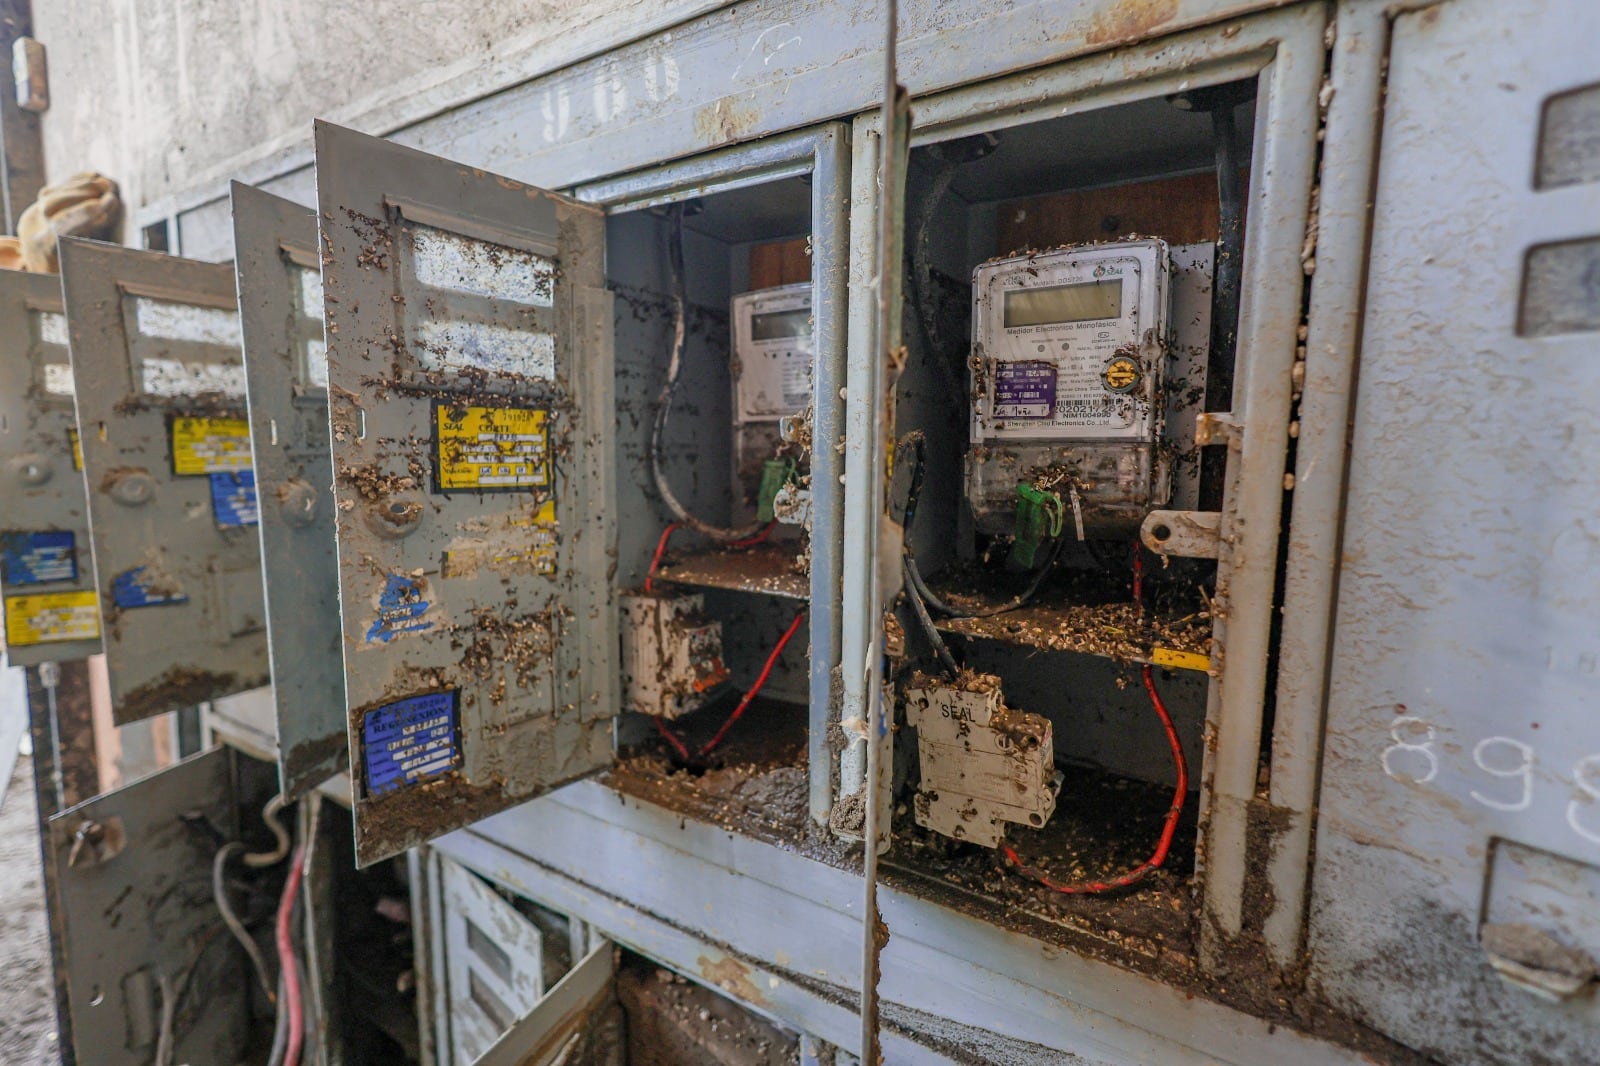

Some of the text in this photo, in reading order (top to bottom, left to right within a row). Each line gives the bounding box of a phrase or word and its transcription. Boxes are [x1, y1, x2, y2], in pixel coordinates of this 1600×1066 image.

[443, 423, 464, 431] SEAL
[1051, 419, 1085, 427] Electronics
[941, 703, 977, 723] SEAL
